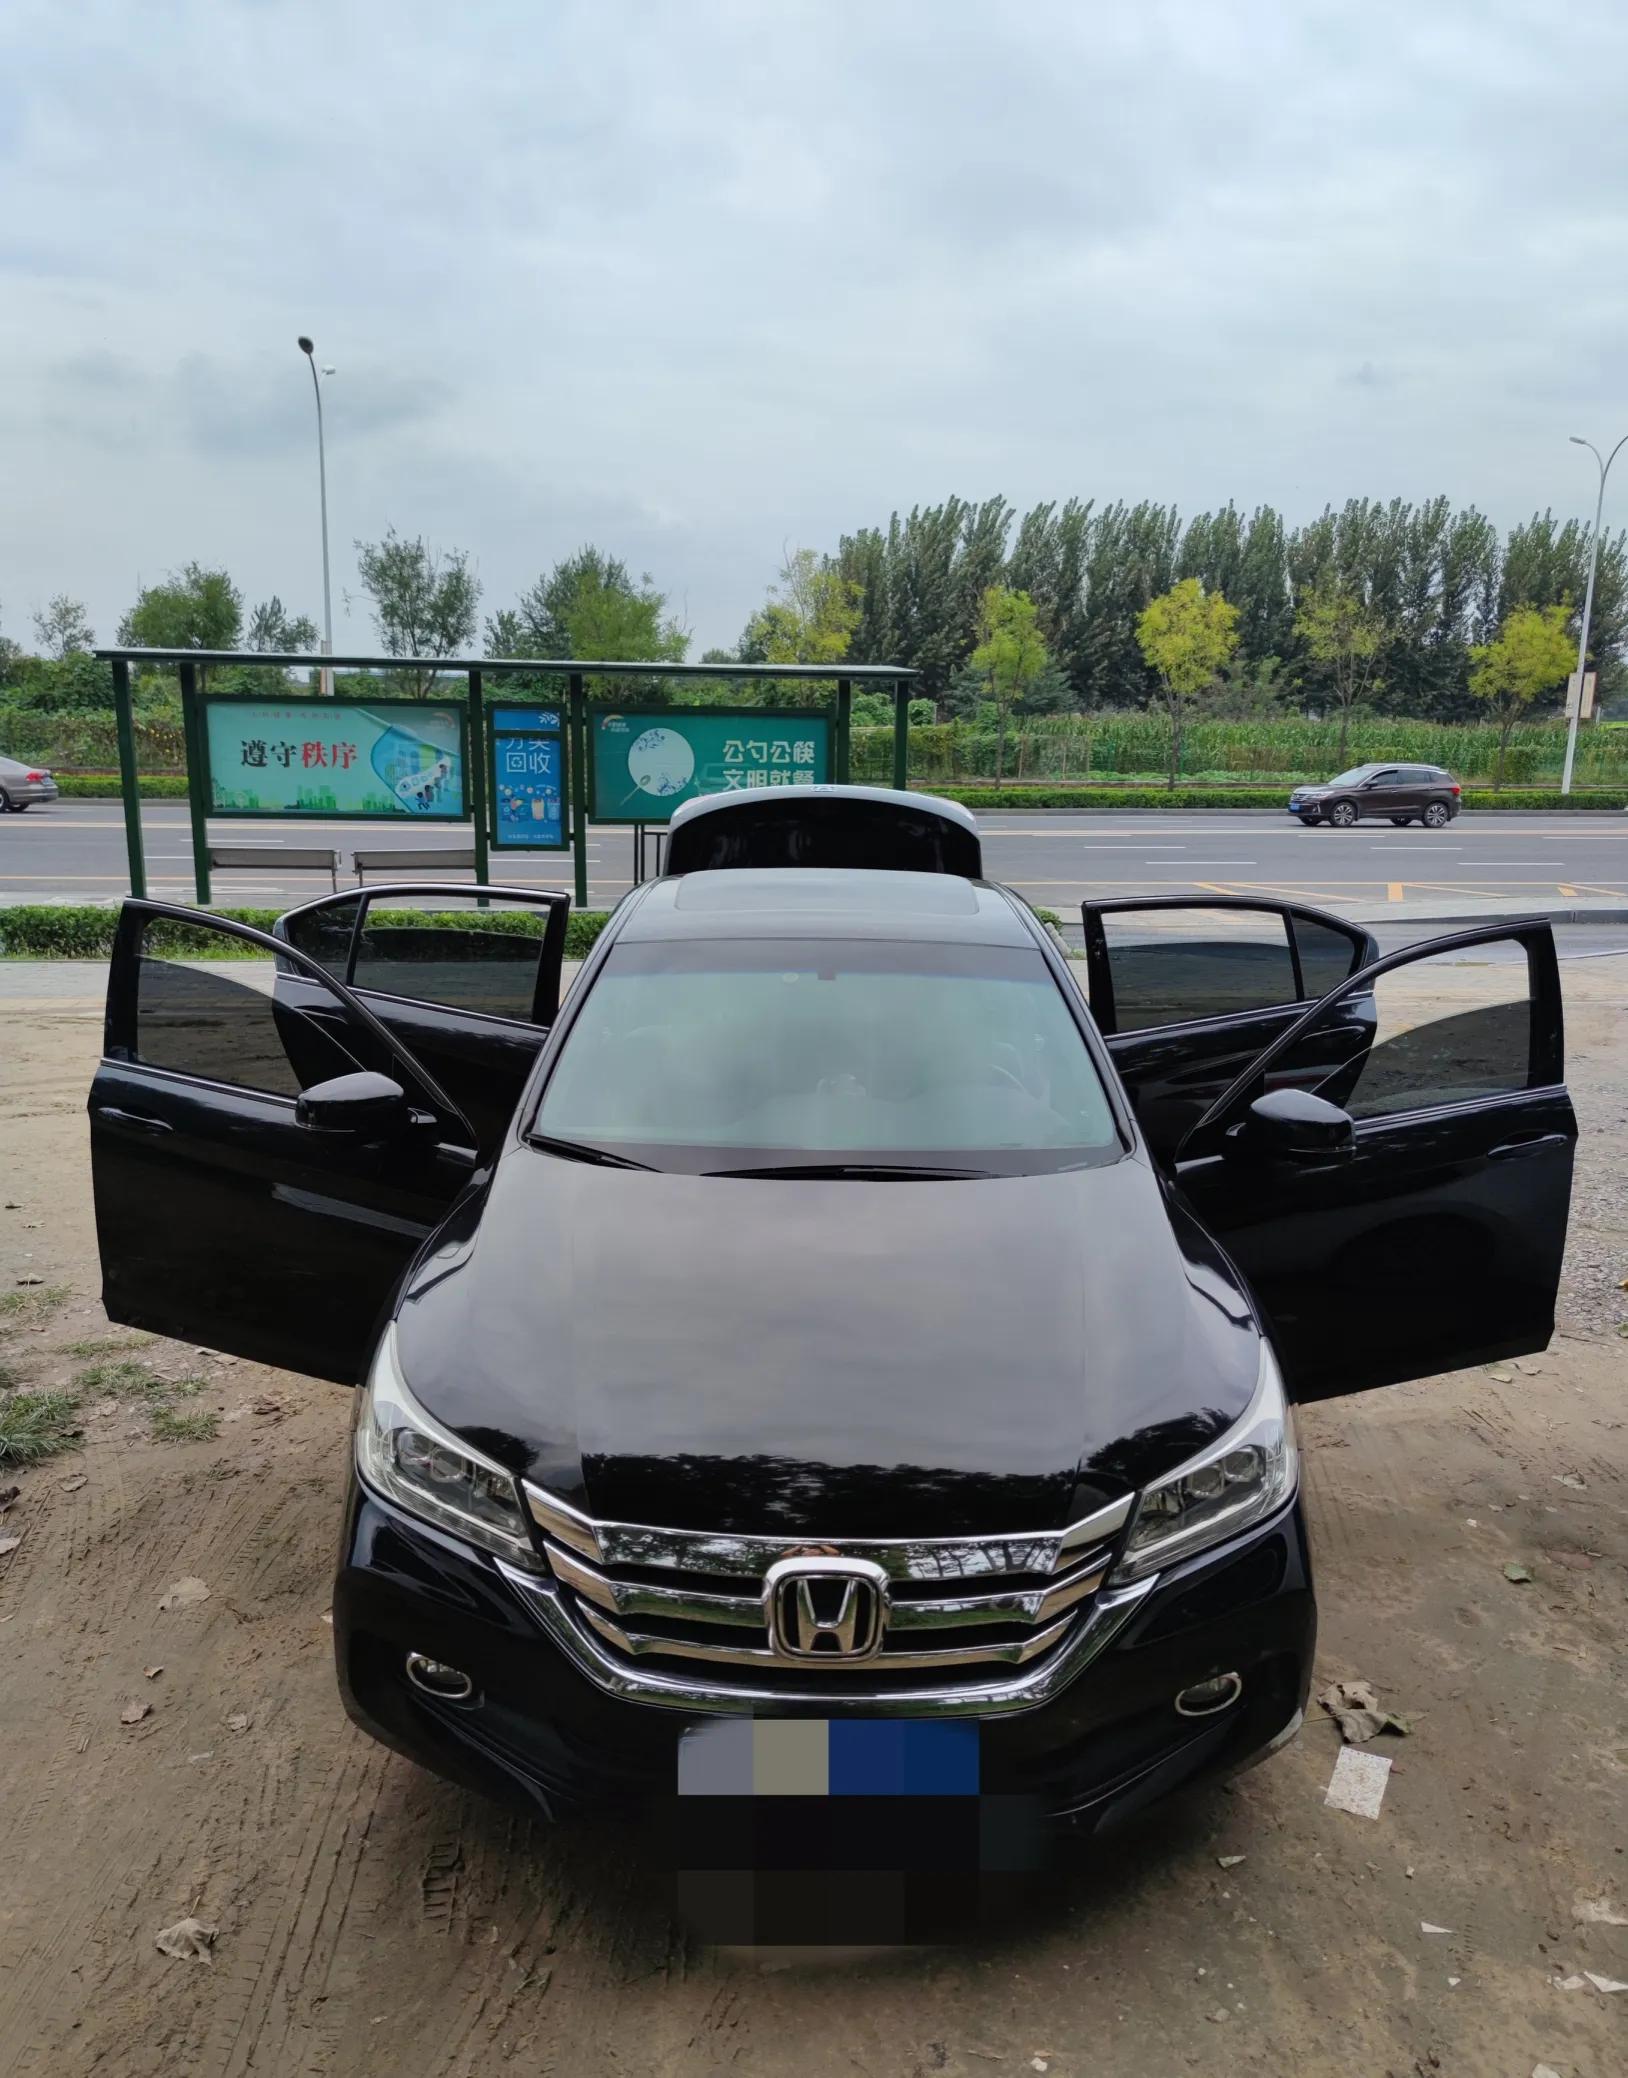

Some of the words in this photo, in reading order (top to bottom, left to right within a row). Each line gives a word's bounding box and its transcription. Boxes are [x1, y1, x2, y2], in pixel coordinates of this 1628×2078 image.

[240, 740, 358, 770] 遵守秩序
[506, 752, 551, 774] 回收
[722, 739, 815, 764] 公勺公筷
[722, 768, 815, 791] 文明就餐
